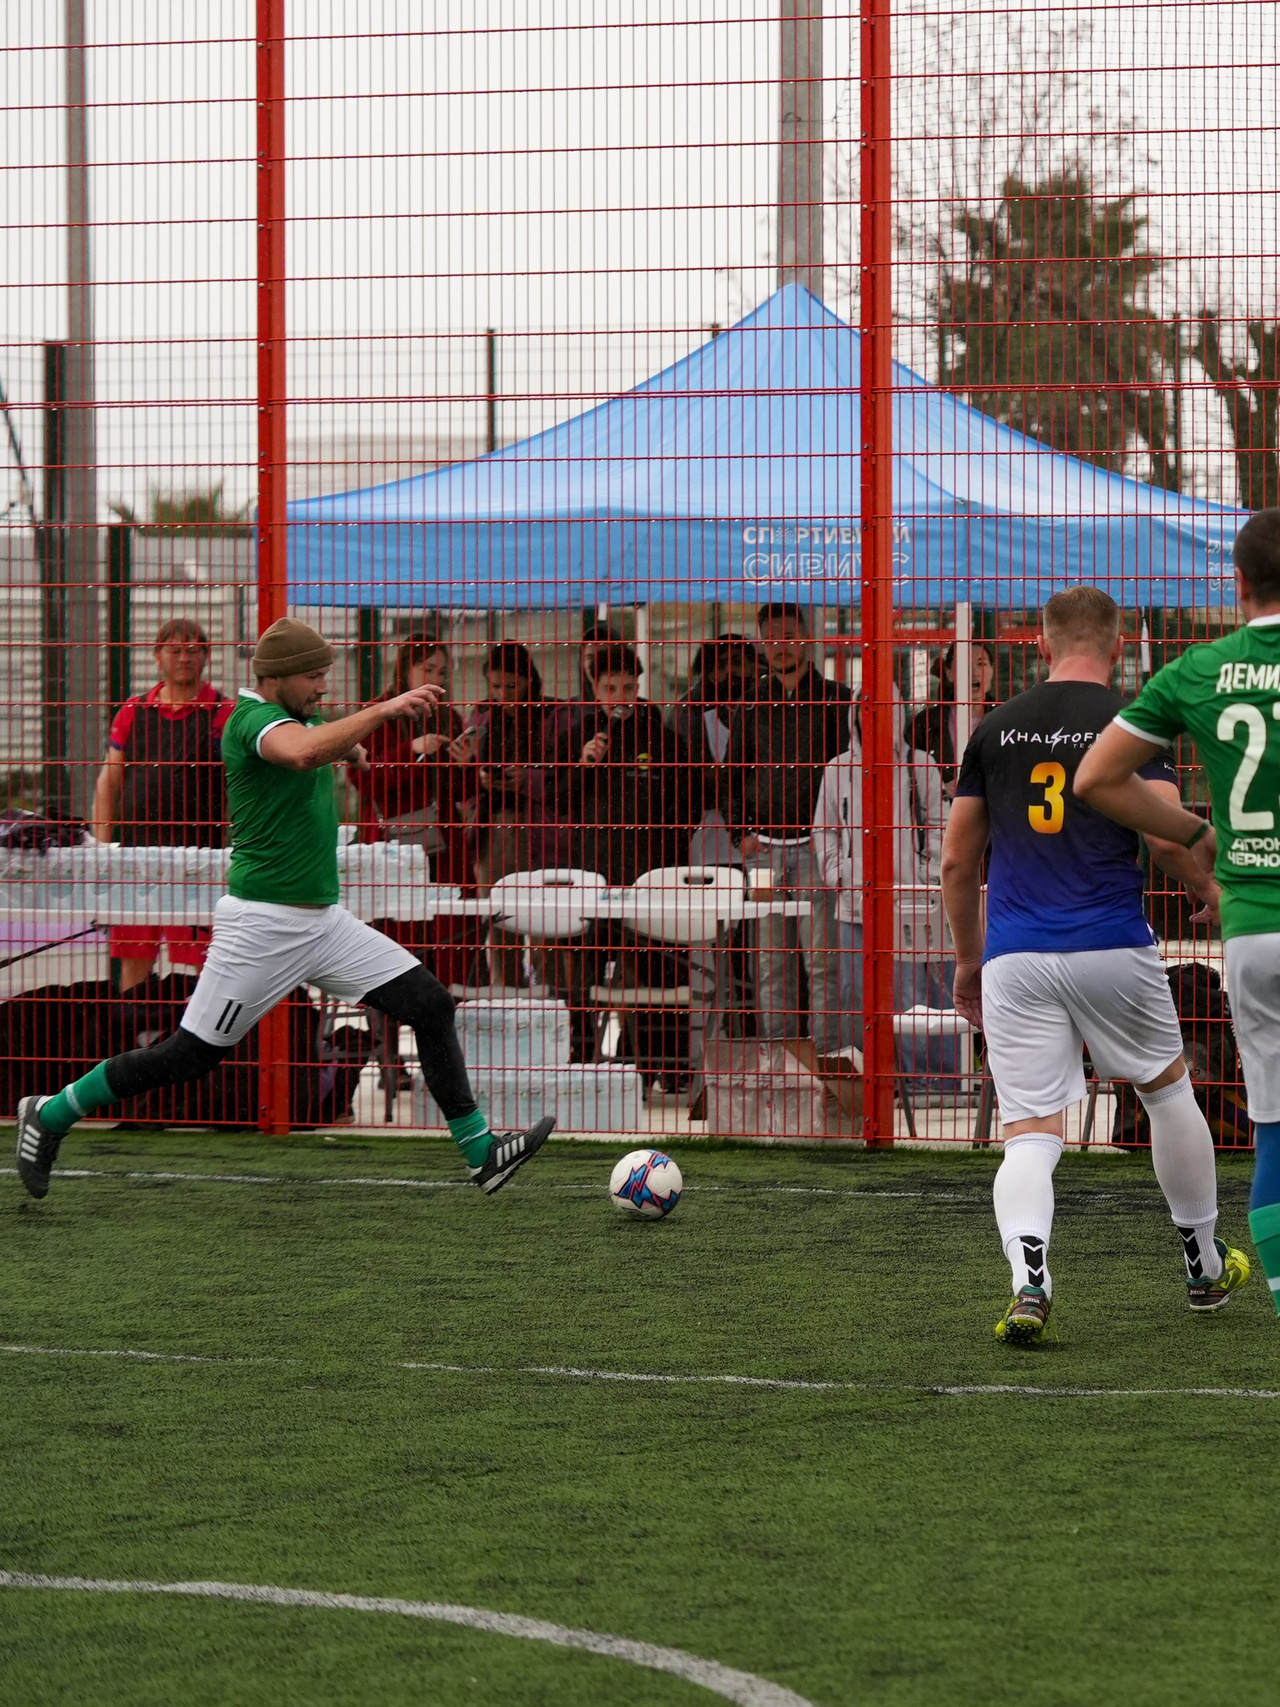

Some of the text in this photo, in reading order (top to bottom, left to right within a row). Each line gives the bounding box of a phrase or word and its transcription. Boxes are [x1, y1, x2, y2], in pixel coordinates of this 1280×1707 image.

[743, 552, 910, 586] СИРИС
[1028, 762, 1066, 834] 3
[215, 1000, 243, 1034] 11
